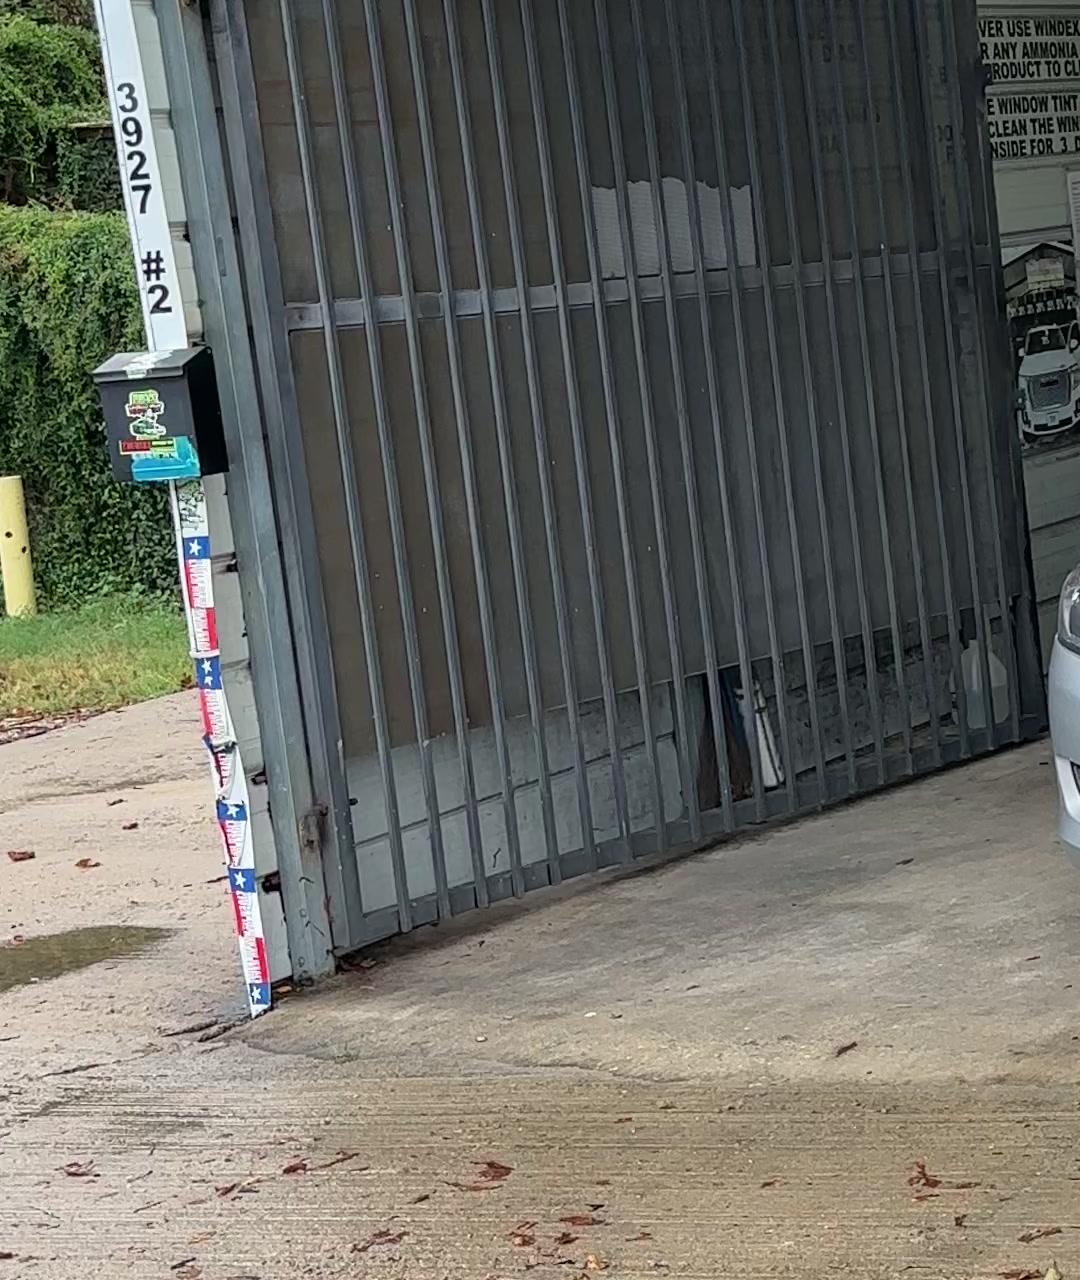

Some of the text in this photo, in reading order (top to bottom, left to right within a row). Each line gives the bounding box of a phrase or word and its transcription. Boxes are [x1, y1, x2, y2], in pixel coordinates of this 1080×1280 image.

[978, 20, 1080, 38] VER USE WINDEX
[993, 42, 1017, 60] ANY
[1022, 42, 1079, 60] AMMONIA
[1045, 60, 1061, 77] TO
[987, 94, 1078, 115] E WINDOW TINT
[988, 118, 1027, 138] CLEAN
[1030, 117, 1054, 136] THE
[117, 82, 153, 215] 3927
[1030, 137, 1054, 156] FOR
[1061, 136, 1068, 153] 3
